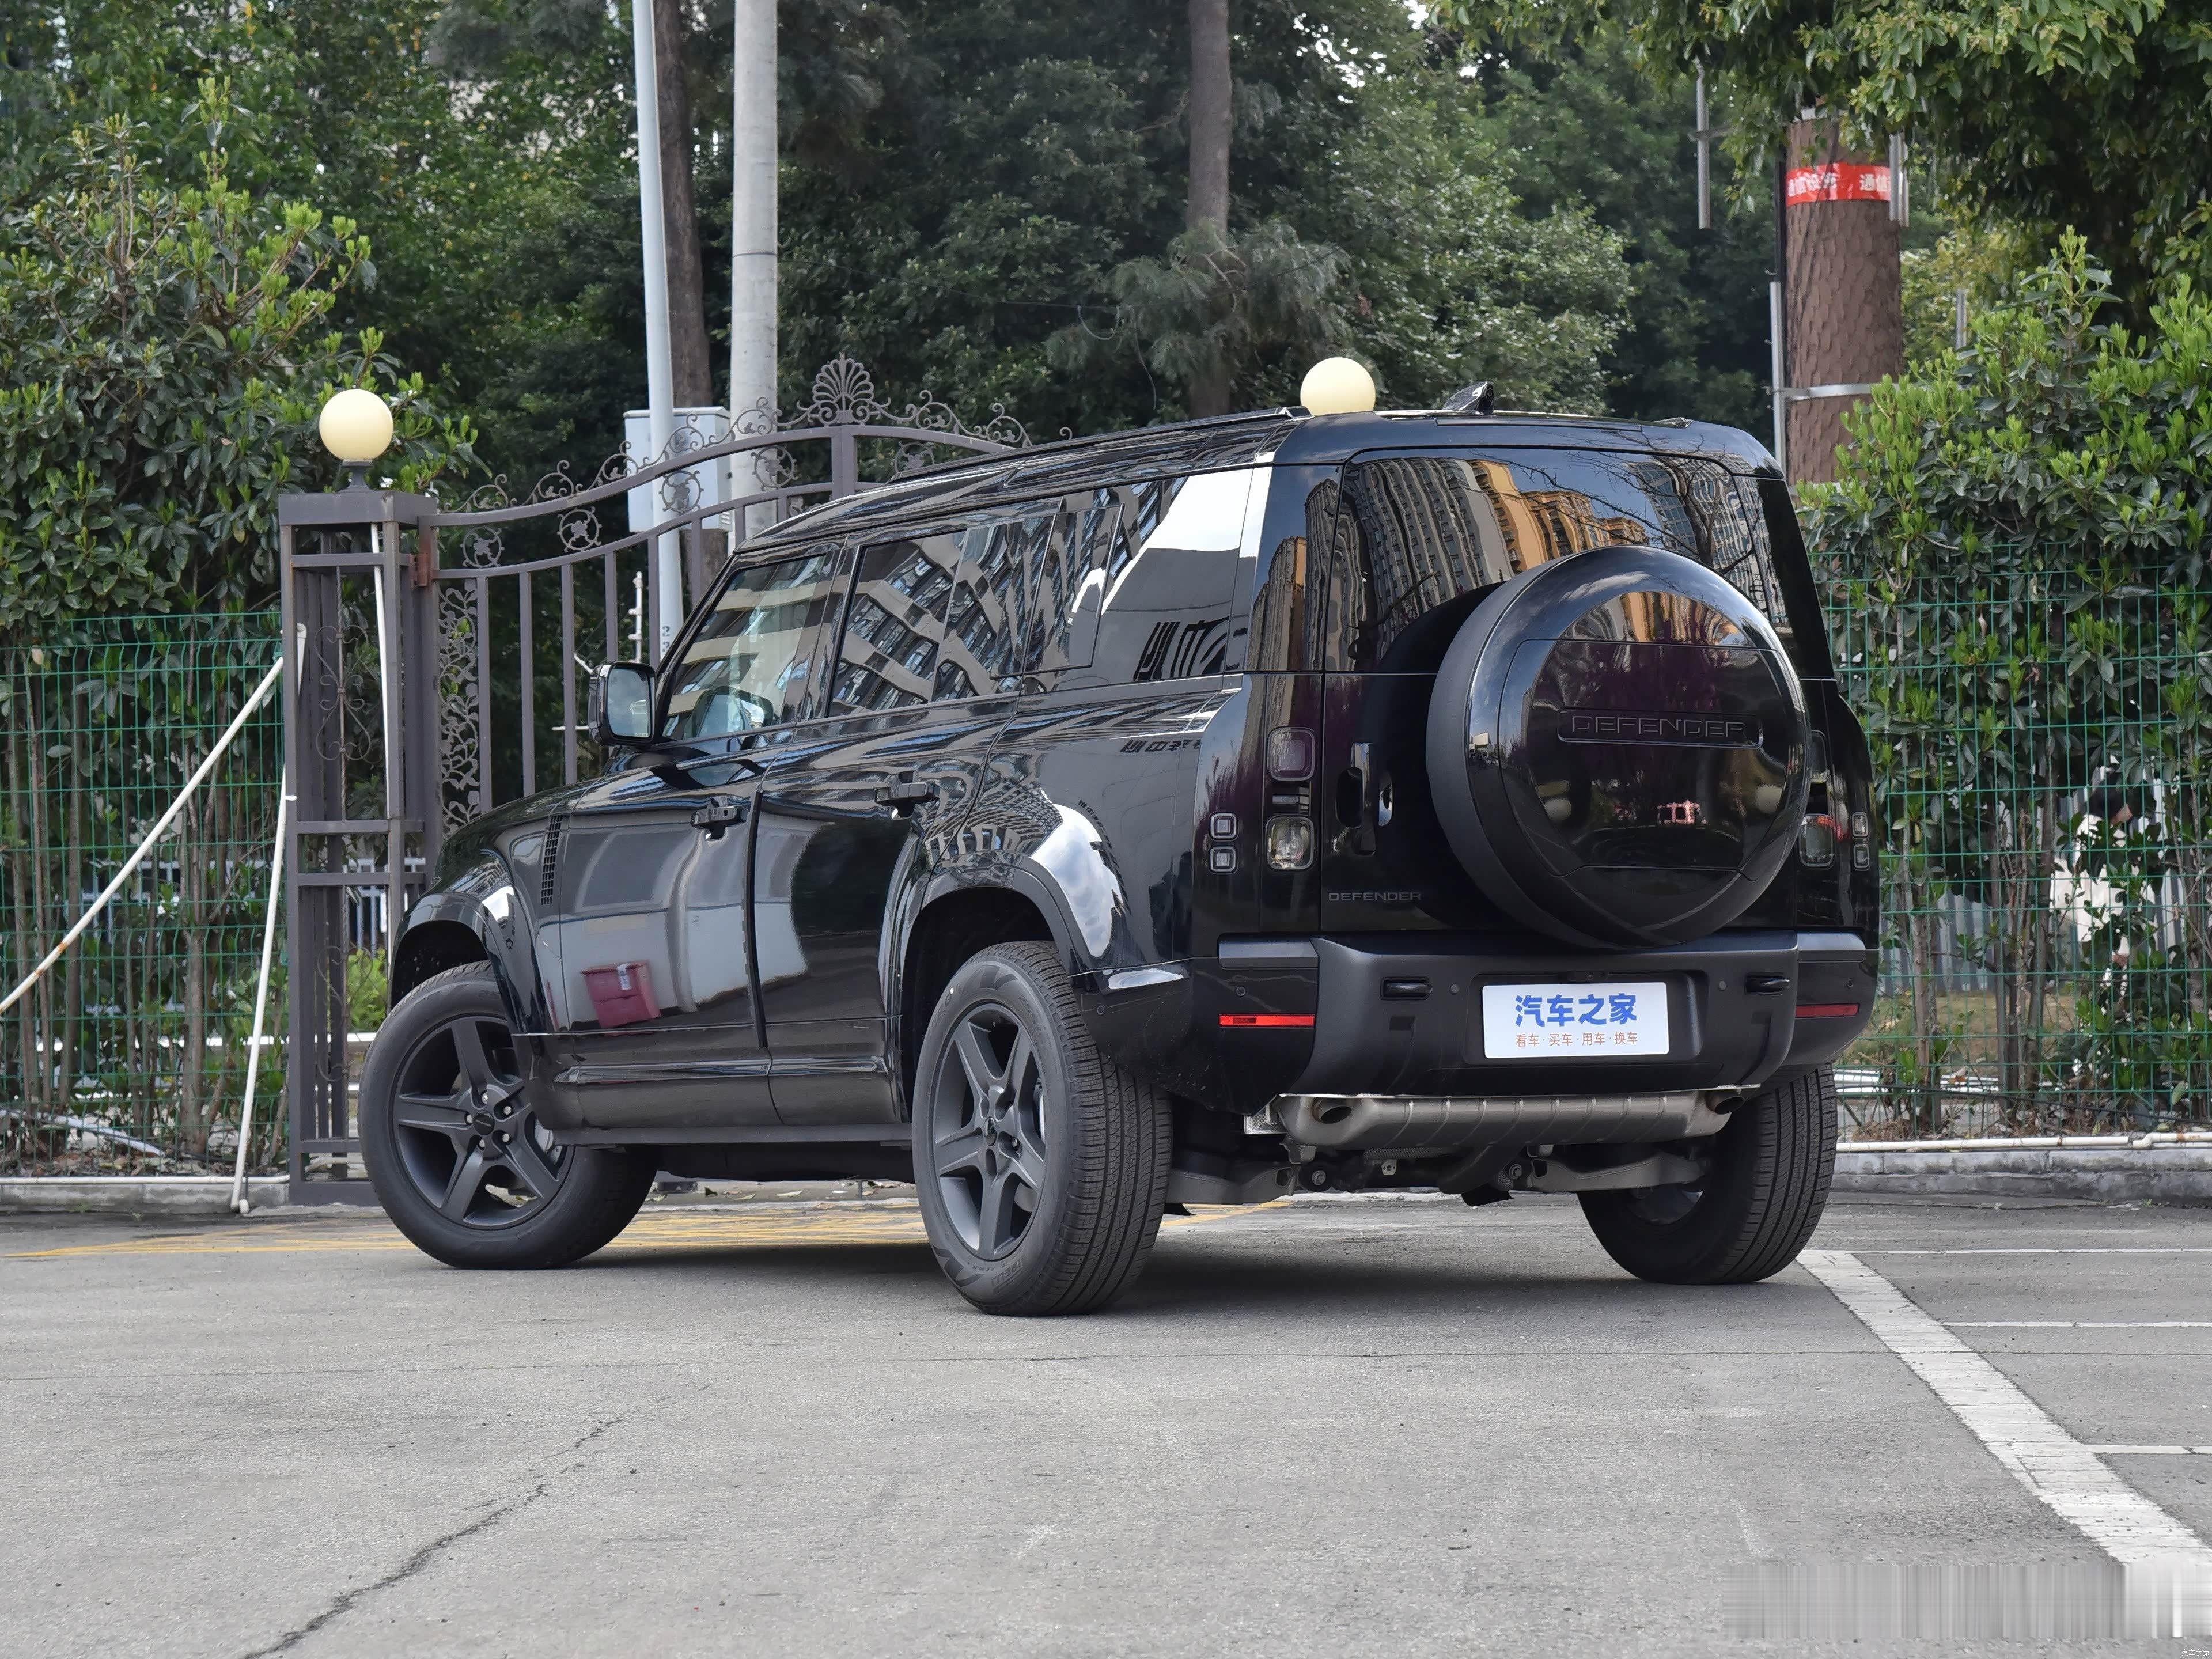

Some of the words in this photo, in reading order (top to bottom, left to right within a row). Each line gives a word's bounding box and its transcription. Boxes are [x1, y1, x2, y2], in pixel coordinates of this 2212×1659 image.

[1571, 715, 1748, 739] DEFENDER
[1328, 891, 1422, 902] DEFENDER
[1515, 993, 1637, 1027] 汽车之家
